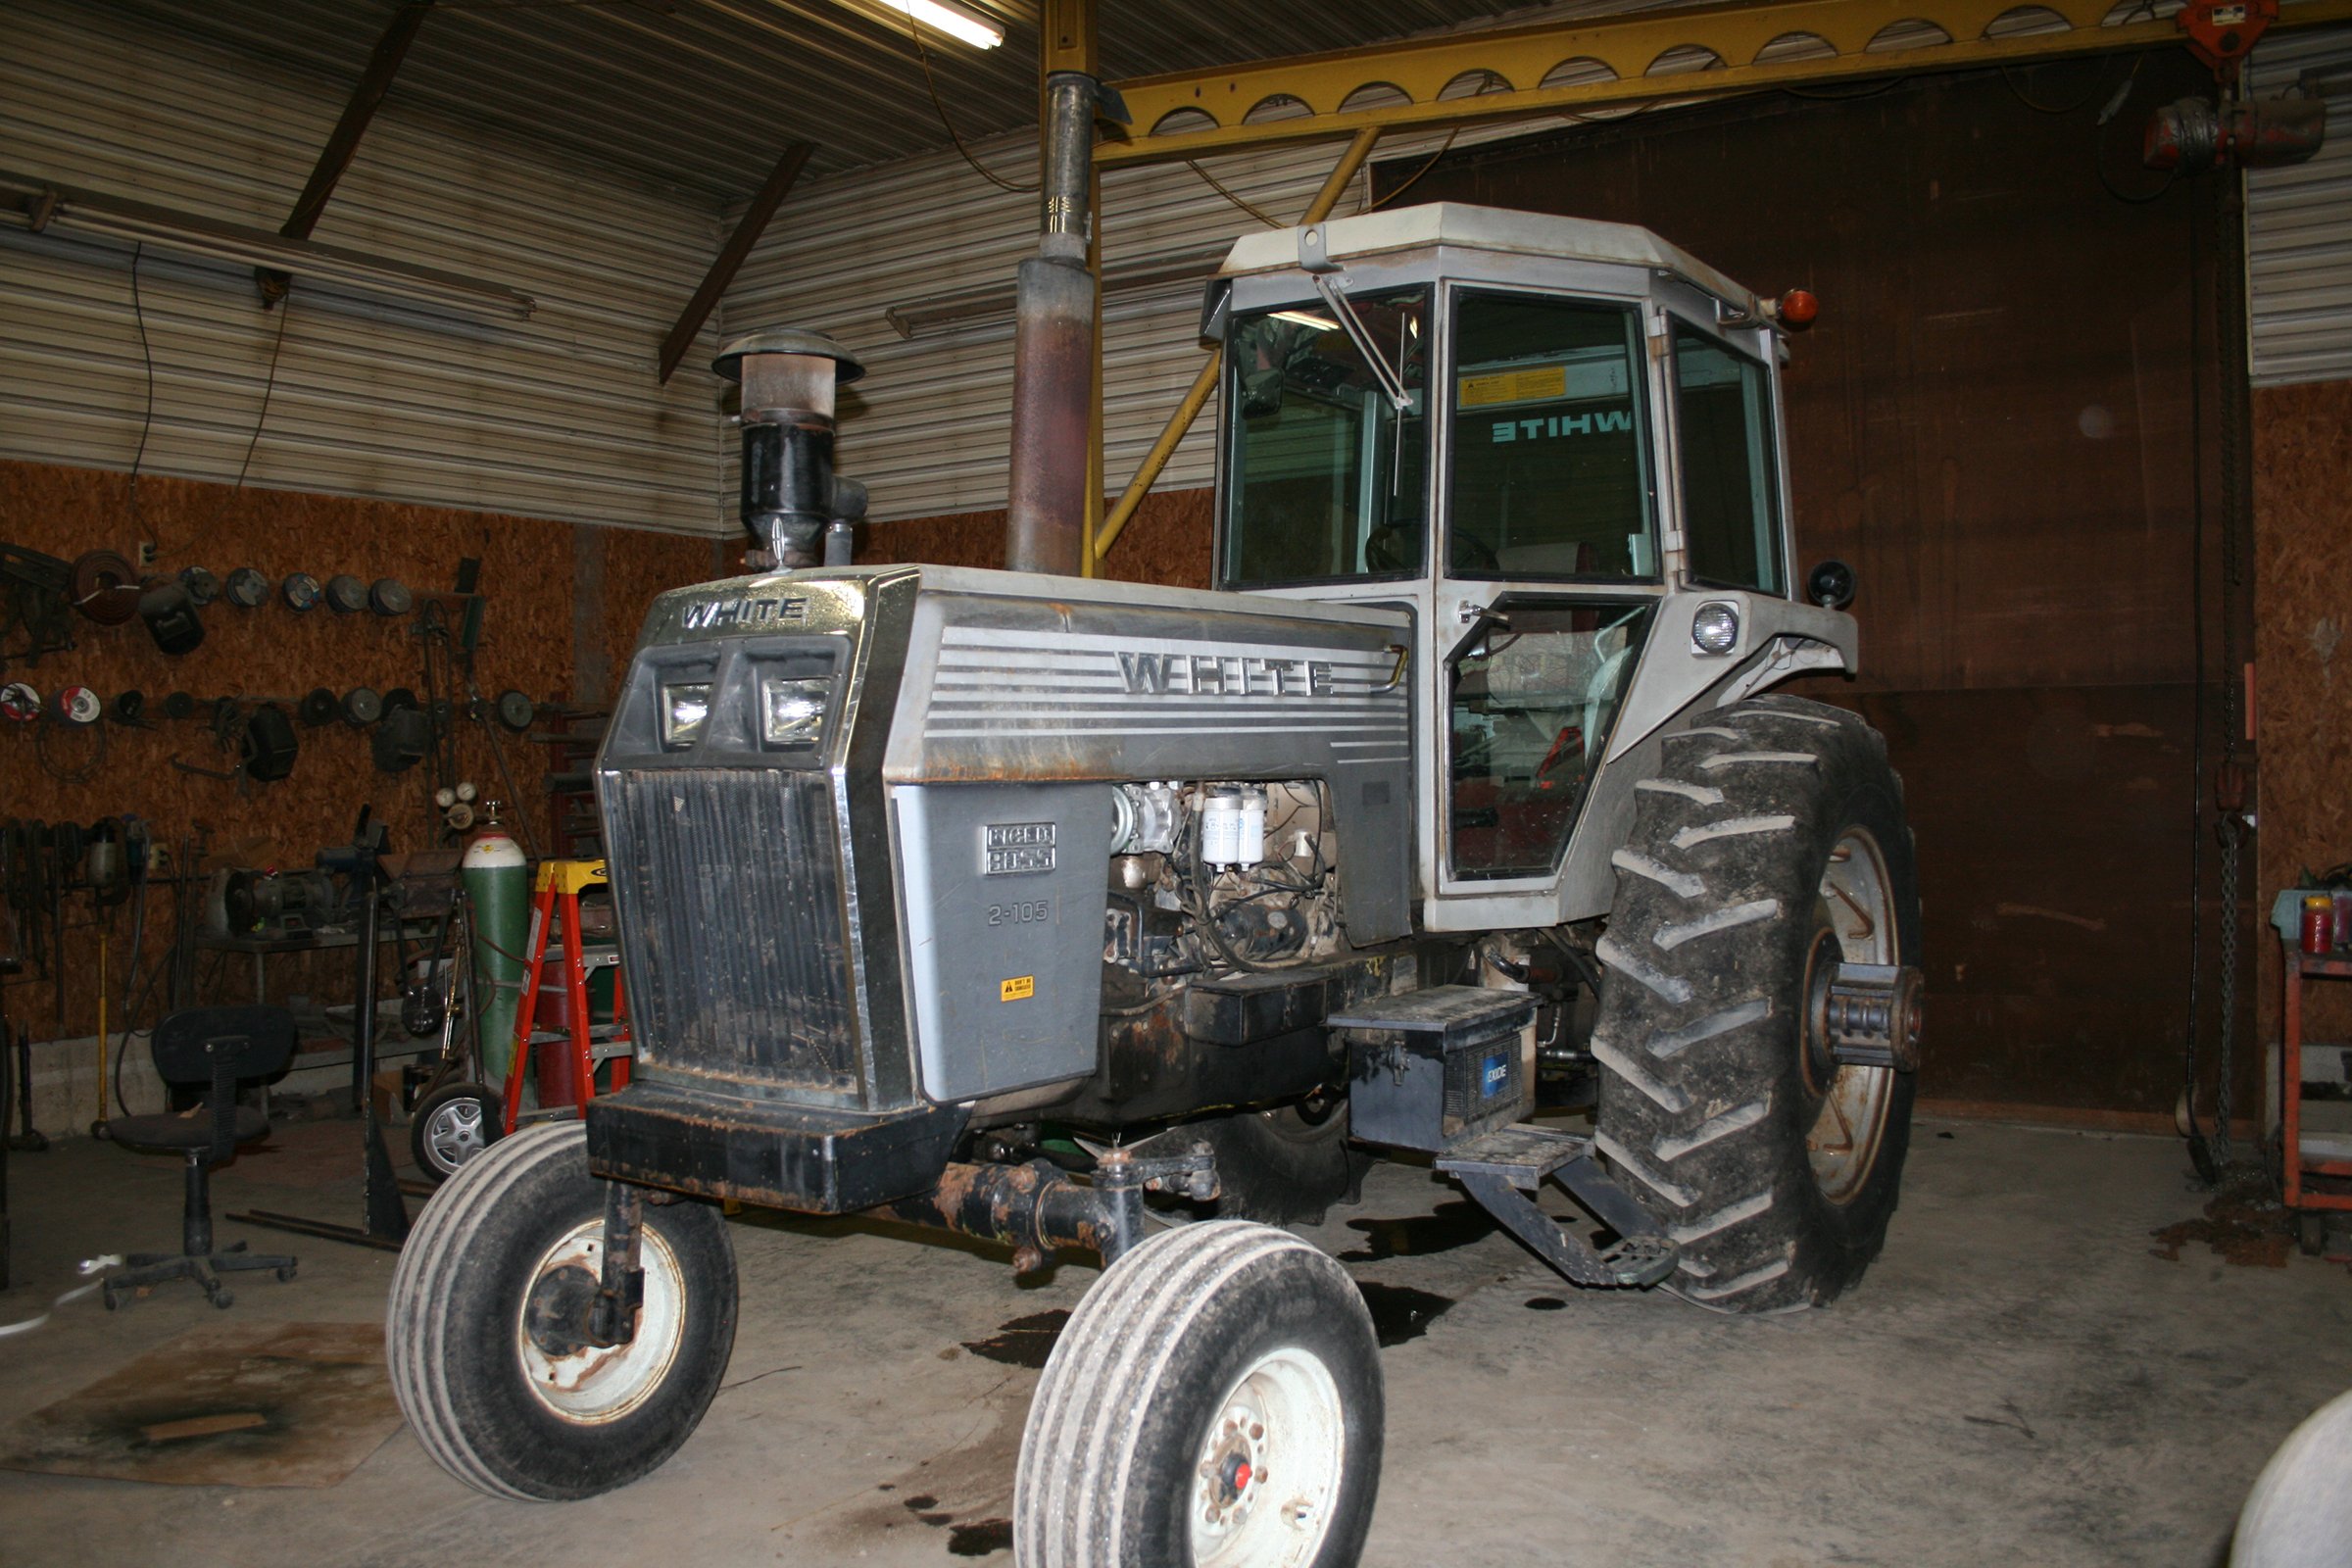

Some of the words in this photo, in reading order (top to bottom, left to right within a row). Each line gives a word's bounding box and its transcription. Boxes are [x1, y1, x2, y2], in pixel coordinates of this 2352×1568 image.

[682, 597, 809, 629] WHITE
[1114, 651, 1334, 697] WHITE
[988, 849, 1052, 872] BOSS
[988, 901, 1049, 926] 2-105
[1488, 1064, 1506, 1082] EXIDE
